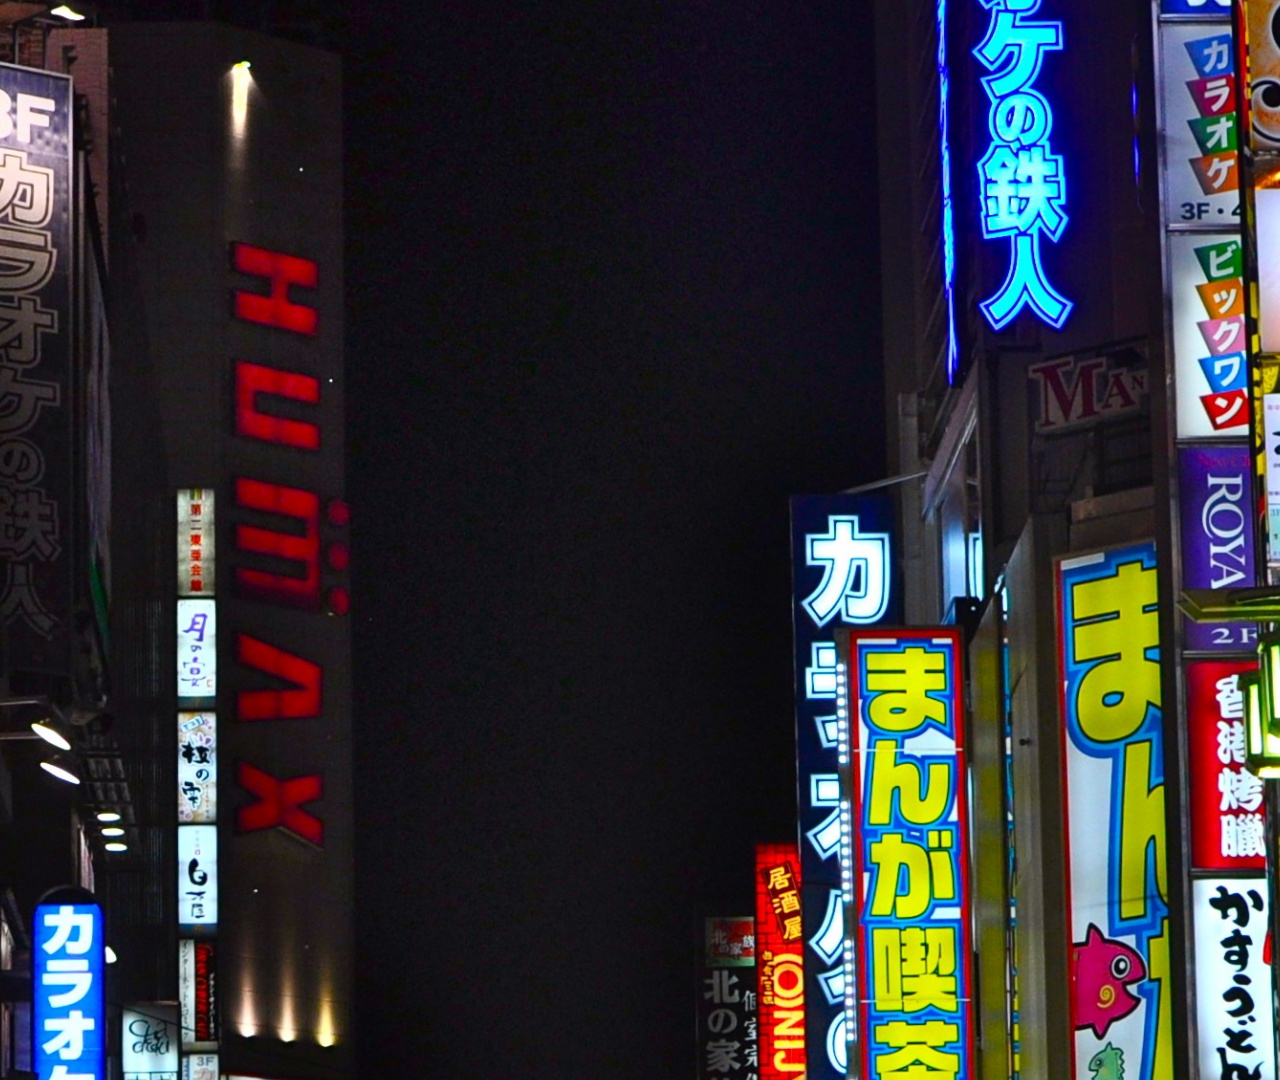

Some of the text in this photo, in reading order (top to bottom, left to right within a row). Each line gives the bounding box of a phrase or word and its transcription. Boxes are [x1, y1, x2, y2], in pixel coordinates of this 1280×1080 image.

[1200, 45, 1234, 188] カラオケ
[1210, 246, 1243, 428] ビックワン
[767, 865, 803, 942] 居酒屋
[196, 1056, 215, 1067] 3F
